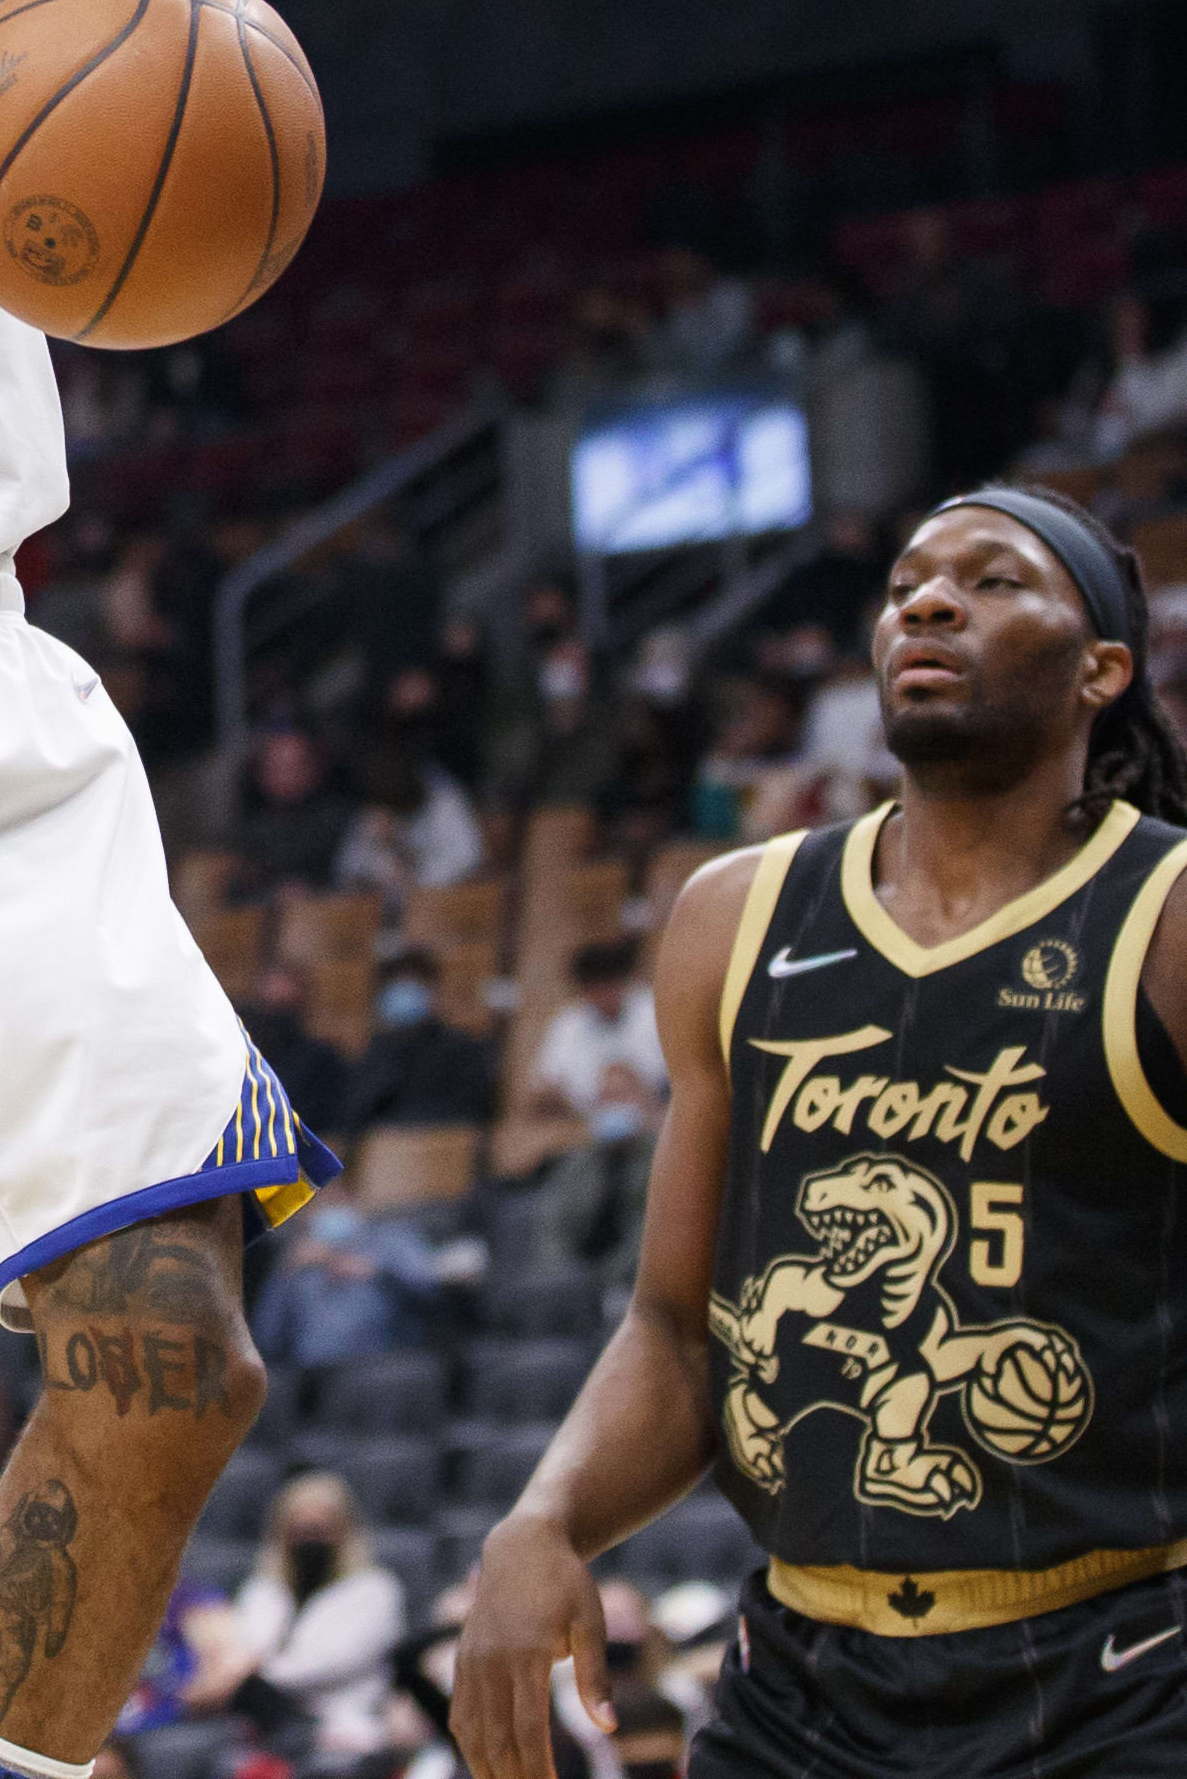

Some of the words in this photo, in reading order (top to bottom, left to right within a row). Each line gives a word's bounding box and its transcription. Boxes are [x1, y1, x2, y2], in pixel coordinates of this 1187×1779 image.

[997, 988, 1040, 1009] Sun
[1044, 991, 1086, 1013] Life
[747, 1024, 1050, 1163] Toronto
[969, 1182, 1025, 1288] 5
